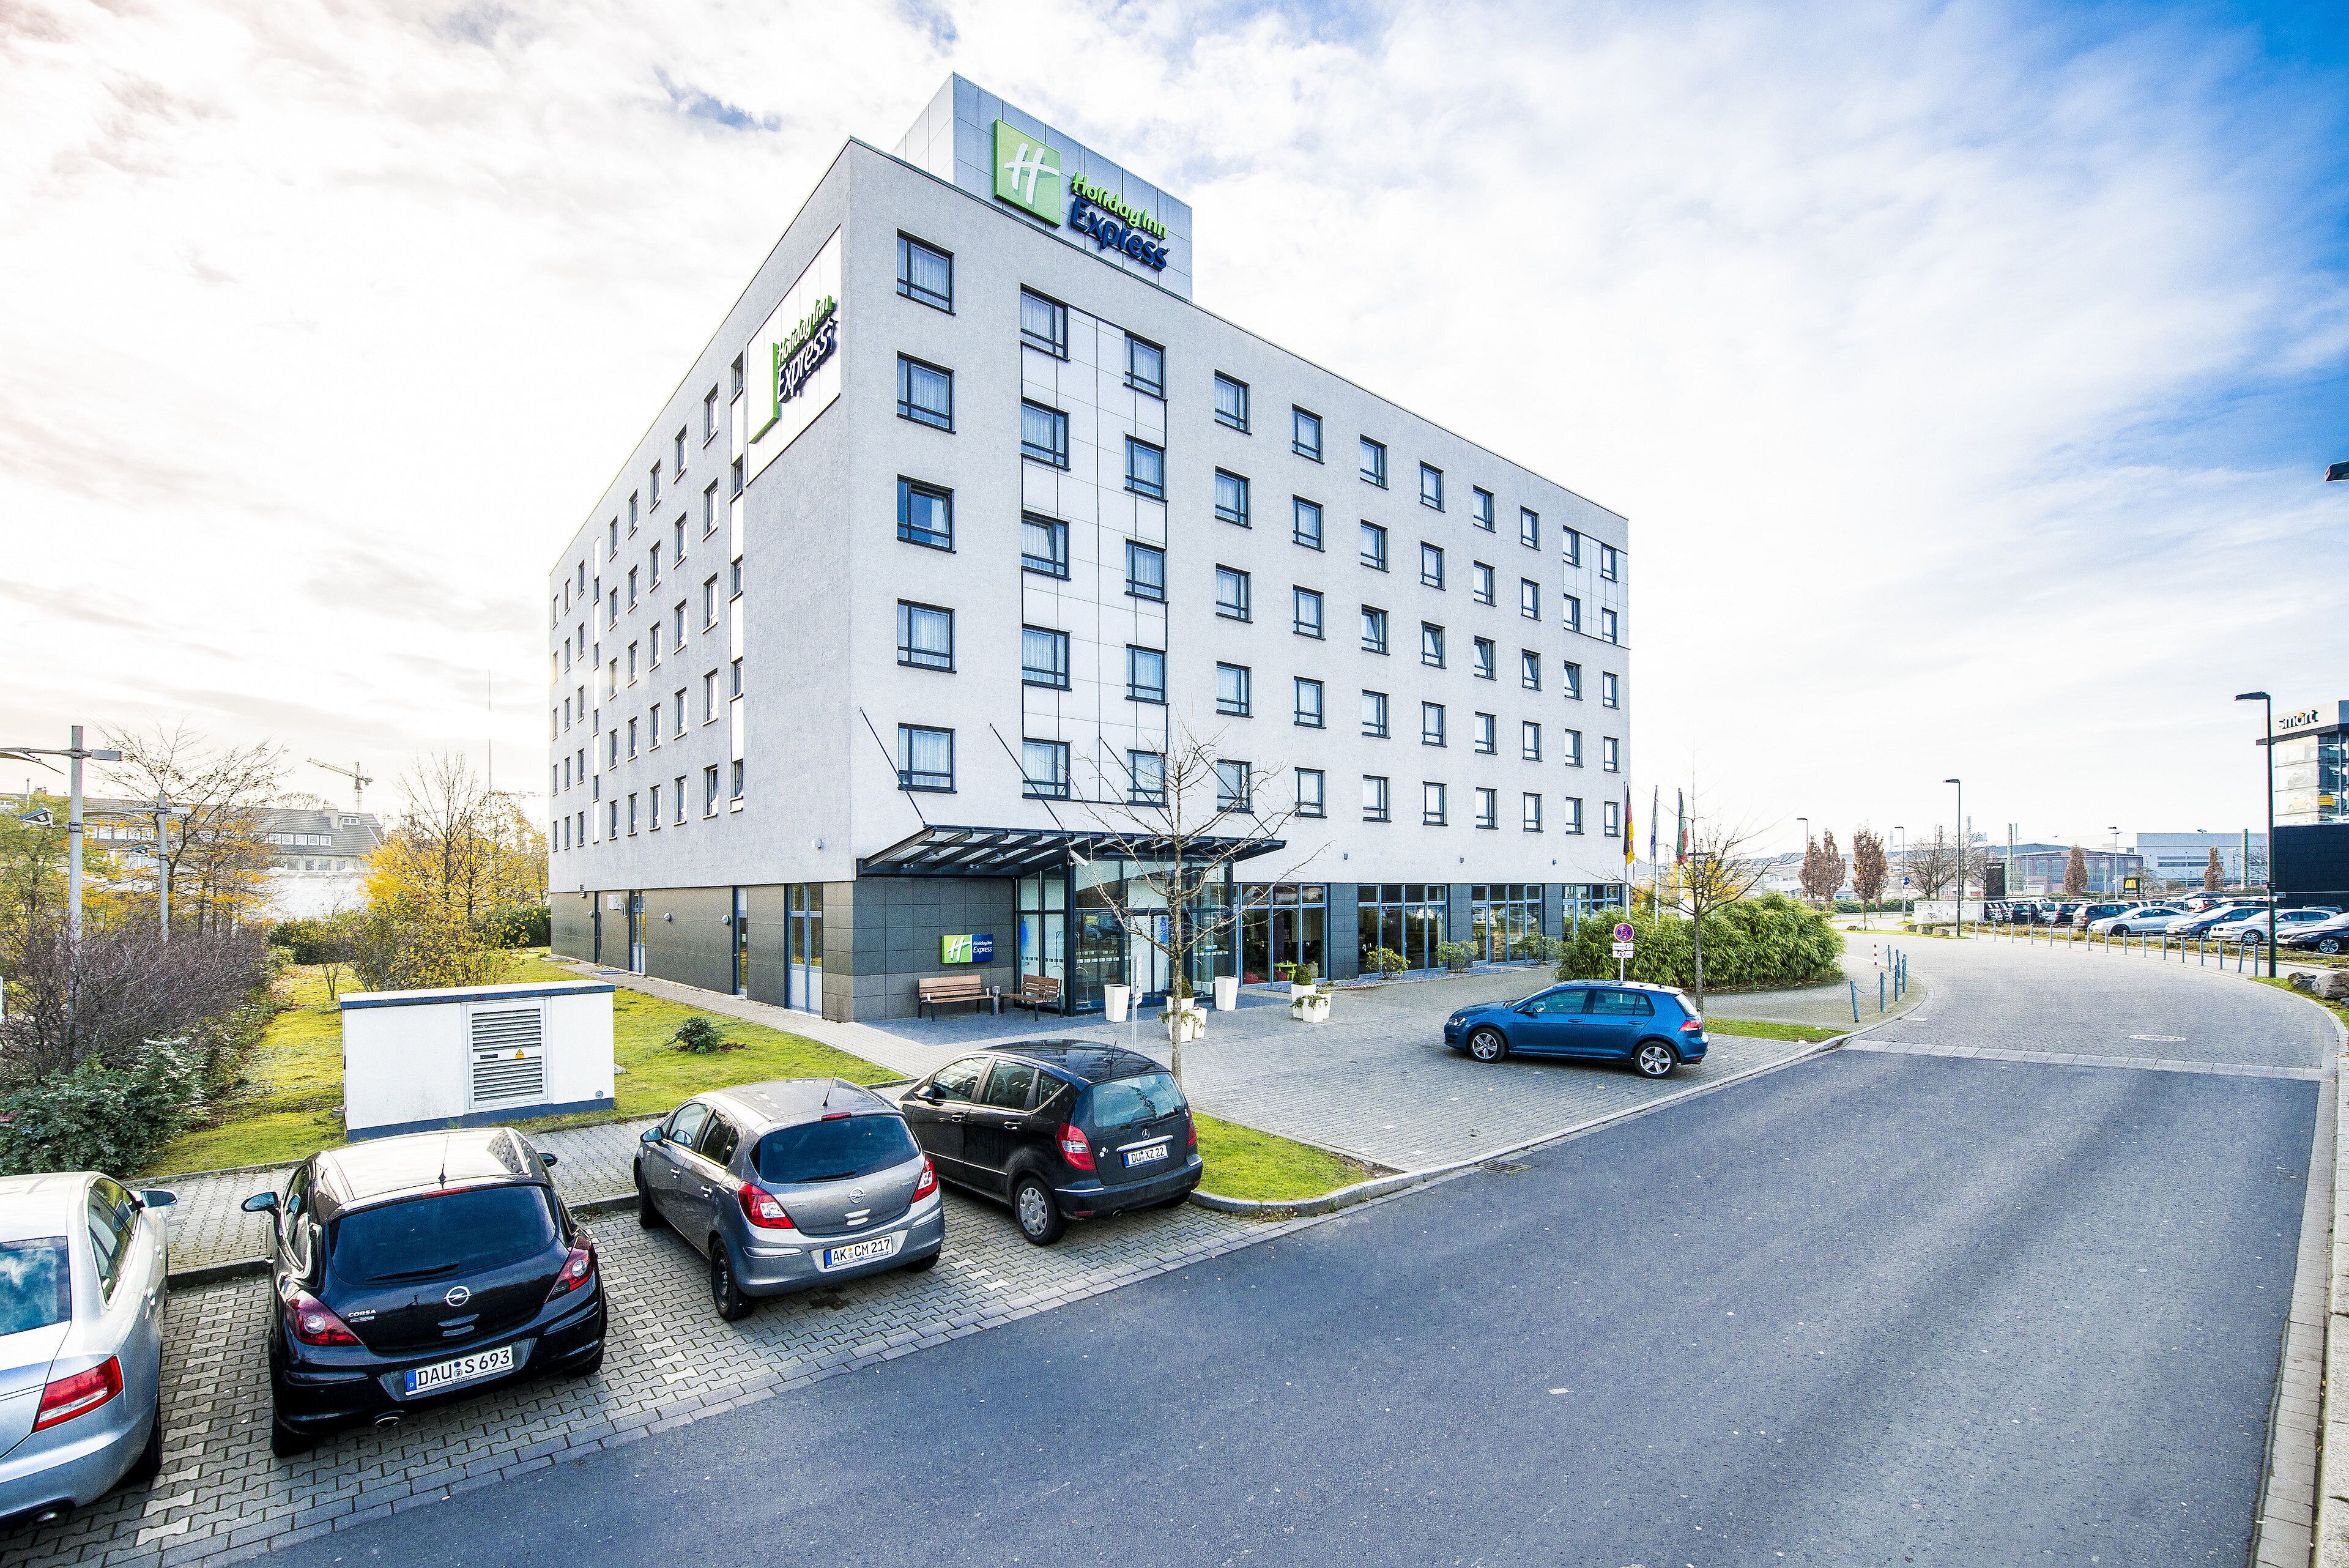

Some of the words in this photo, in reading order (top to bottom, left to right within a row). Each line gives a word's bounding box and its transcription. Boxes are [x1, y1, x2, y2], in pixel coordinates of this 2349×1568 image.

[1071, 171, 1141, 228] Holiday
[1142, 208, 1168, 240] Inn
[1071, 196, 1171, 271] Express
[777, 316, 812, 366] Holiday
[813, 295, 832, 325] Inn
[777, 317, 835, 402] Express
[2277, 710, 2318, 729] smart
[1131, 1153, 1141, 1163] DU
[1145, 1150, 1154, 1159] XZ
[1156, 1147, 1165, 1157] 22
[833, 1248, 847, 1262] AK
[855, 1243, 869, 1257] CM
[871, 1239, 890, 1253] 217
[417, 1364, 452, 1386] DAU
[464, 1359, 475, 1373] S
[479, 1349, 510, 1370] 693
